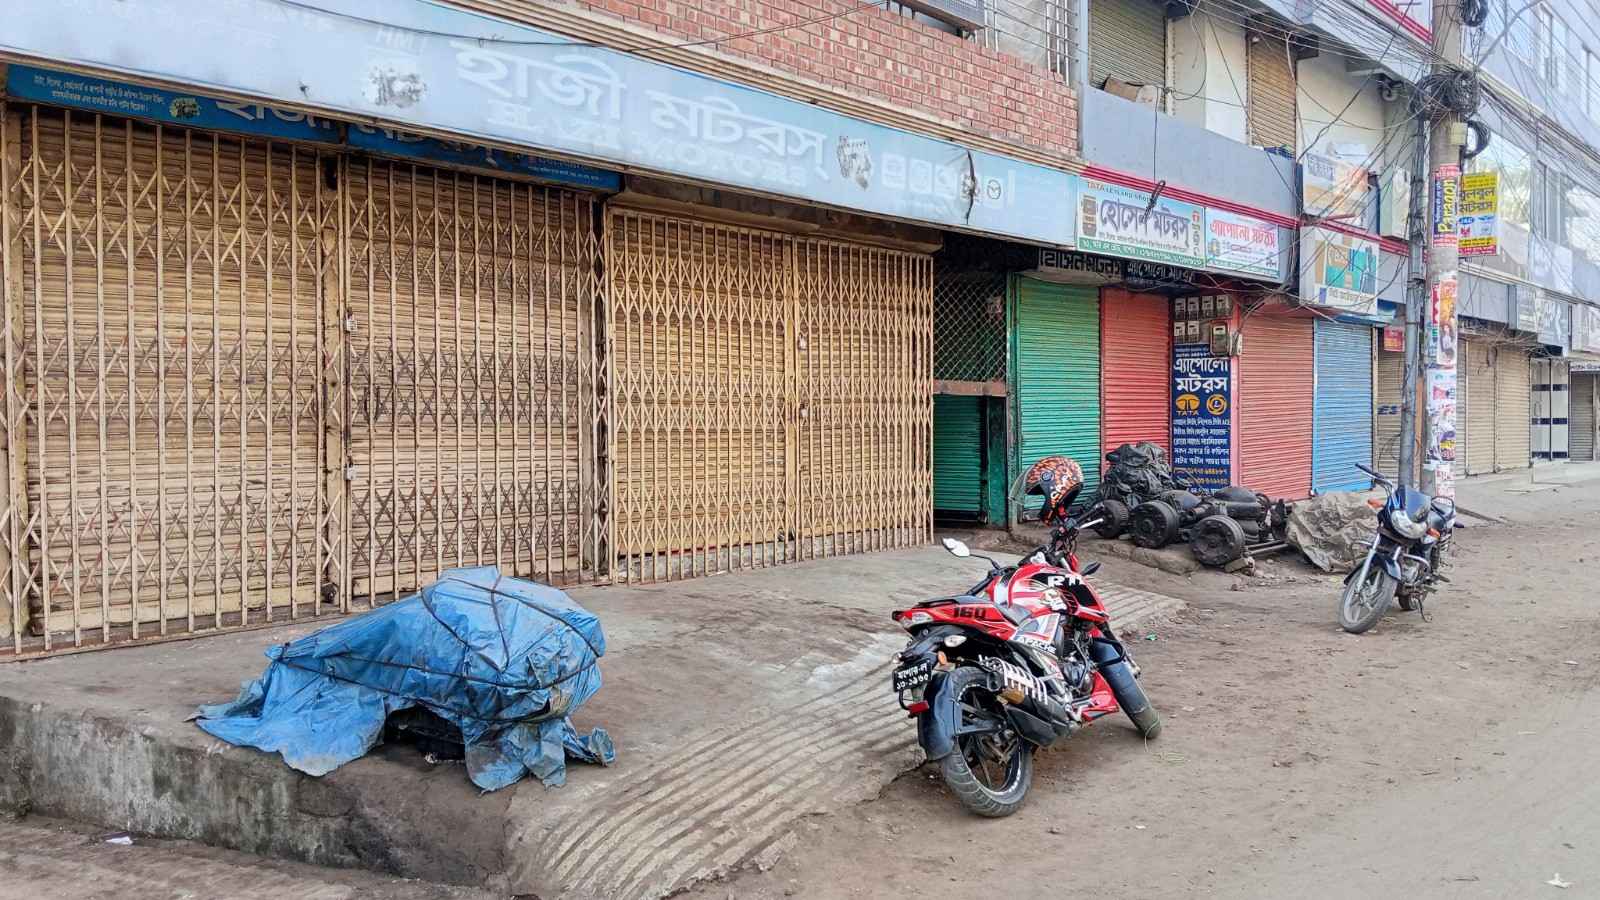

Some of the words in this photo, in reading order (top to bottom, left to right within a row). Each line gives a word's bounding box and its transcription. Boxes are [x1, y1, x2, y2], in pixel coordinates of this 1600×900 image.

[449, 41, 626, 119] হাজী
[1101, 198, 1149, 235] হোসেন
[1174, 357, 1228, 373] এ্যাপোলো
[1175, 373, 1228, 393] মটরস
[953, 606, 986, 619] 160
